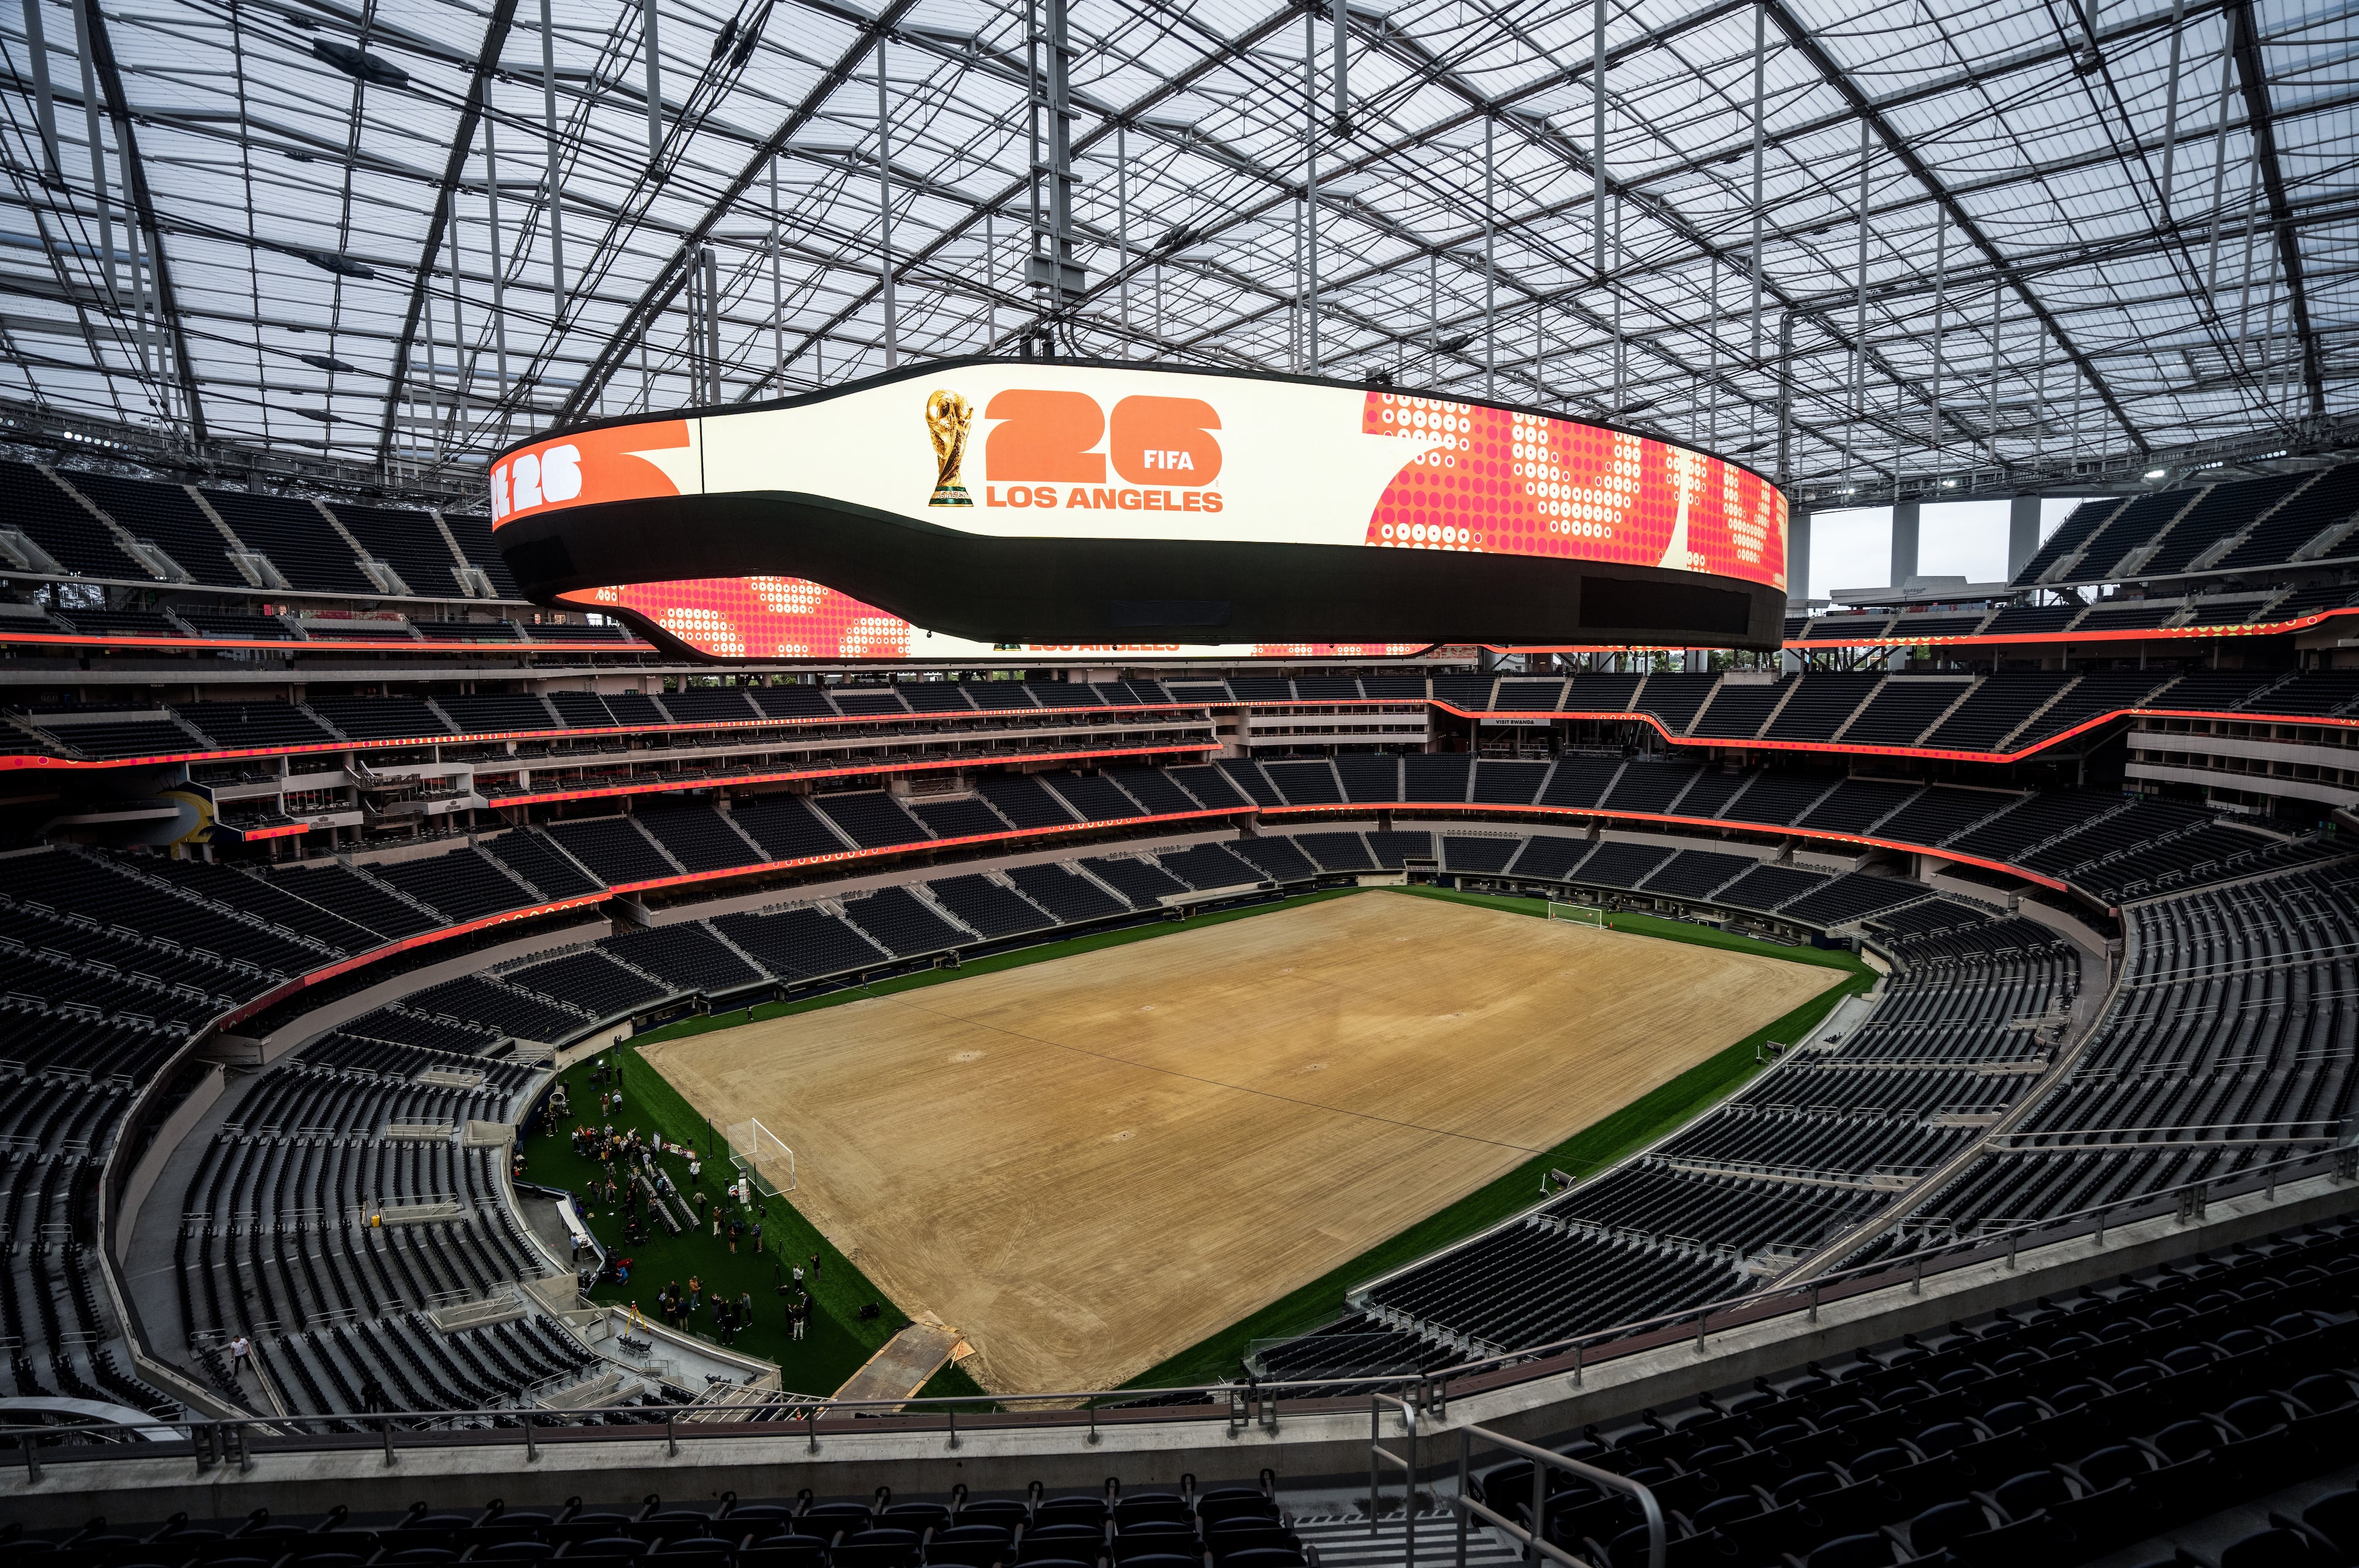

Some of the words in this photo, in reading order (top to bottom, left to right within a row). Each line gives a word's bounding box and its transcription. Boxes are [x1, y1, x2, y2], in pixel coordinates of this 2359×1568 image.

[985, 389, 1223, 487] 26
[1143, 450, 1195, 470] FIFA
[512, 444, 582, 512] 26
[986, 486, 1058, 509] LOS
[1065, 488, 1223, 513] ANGELES
